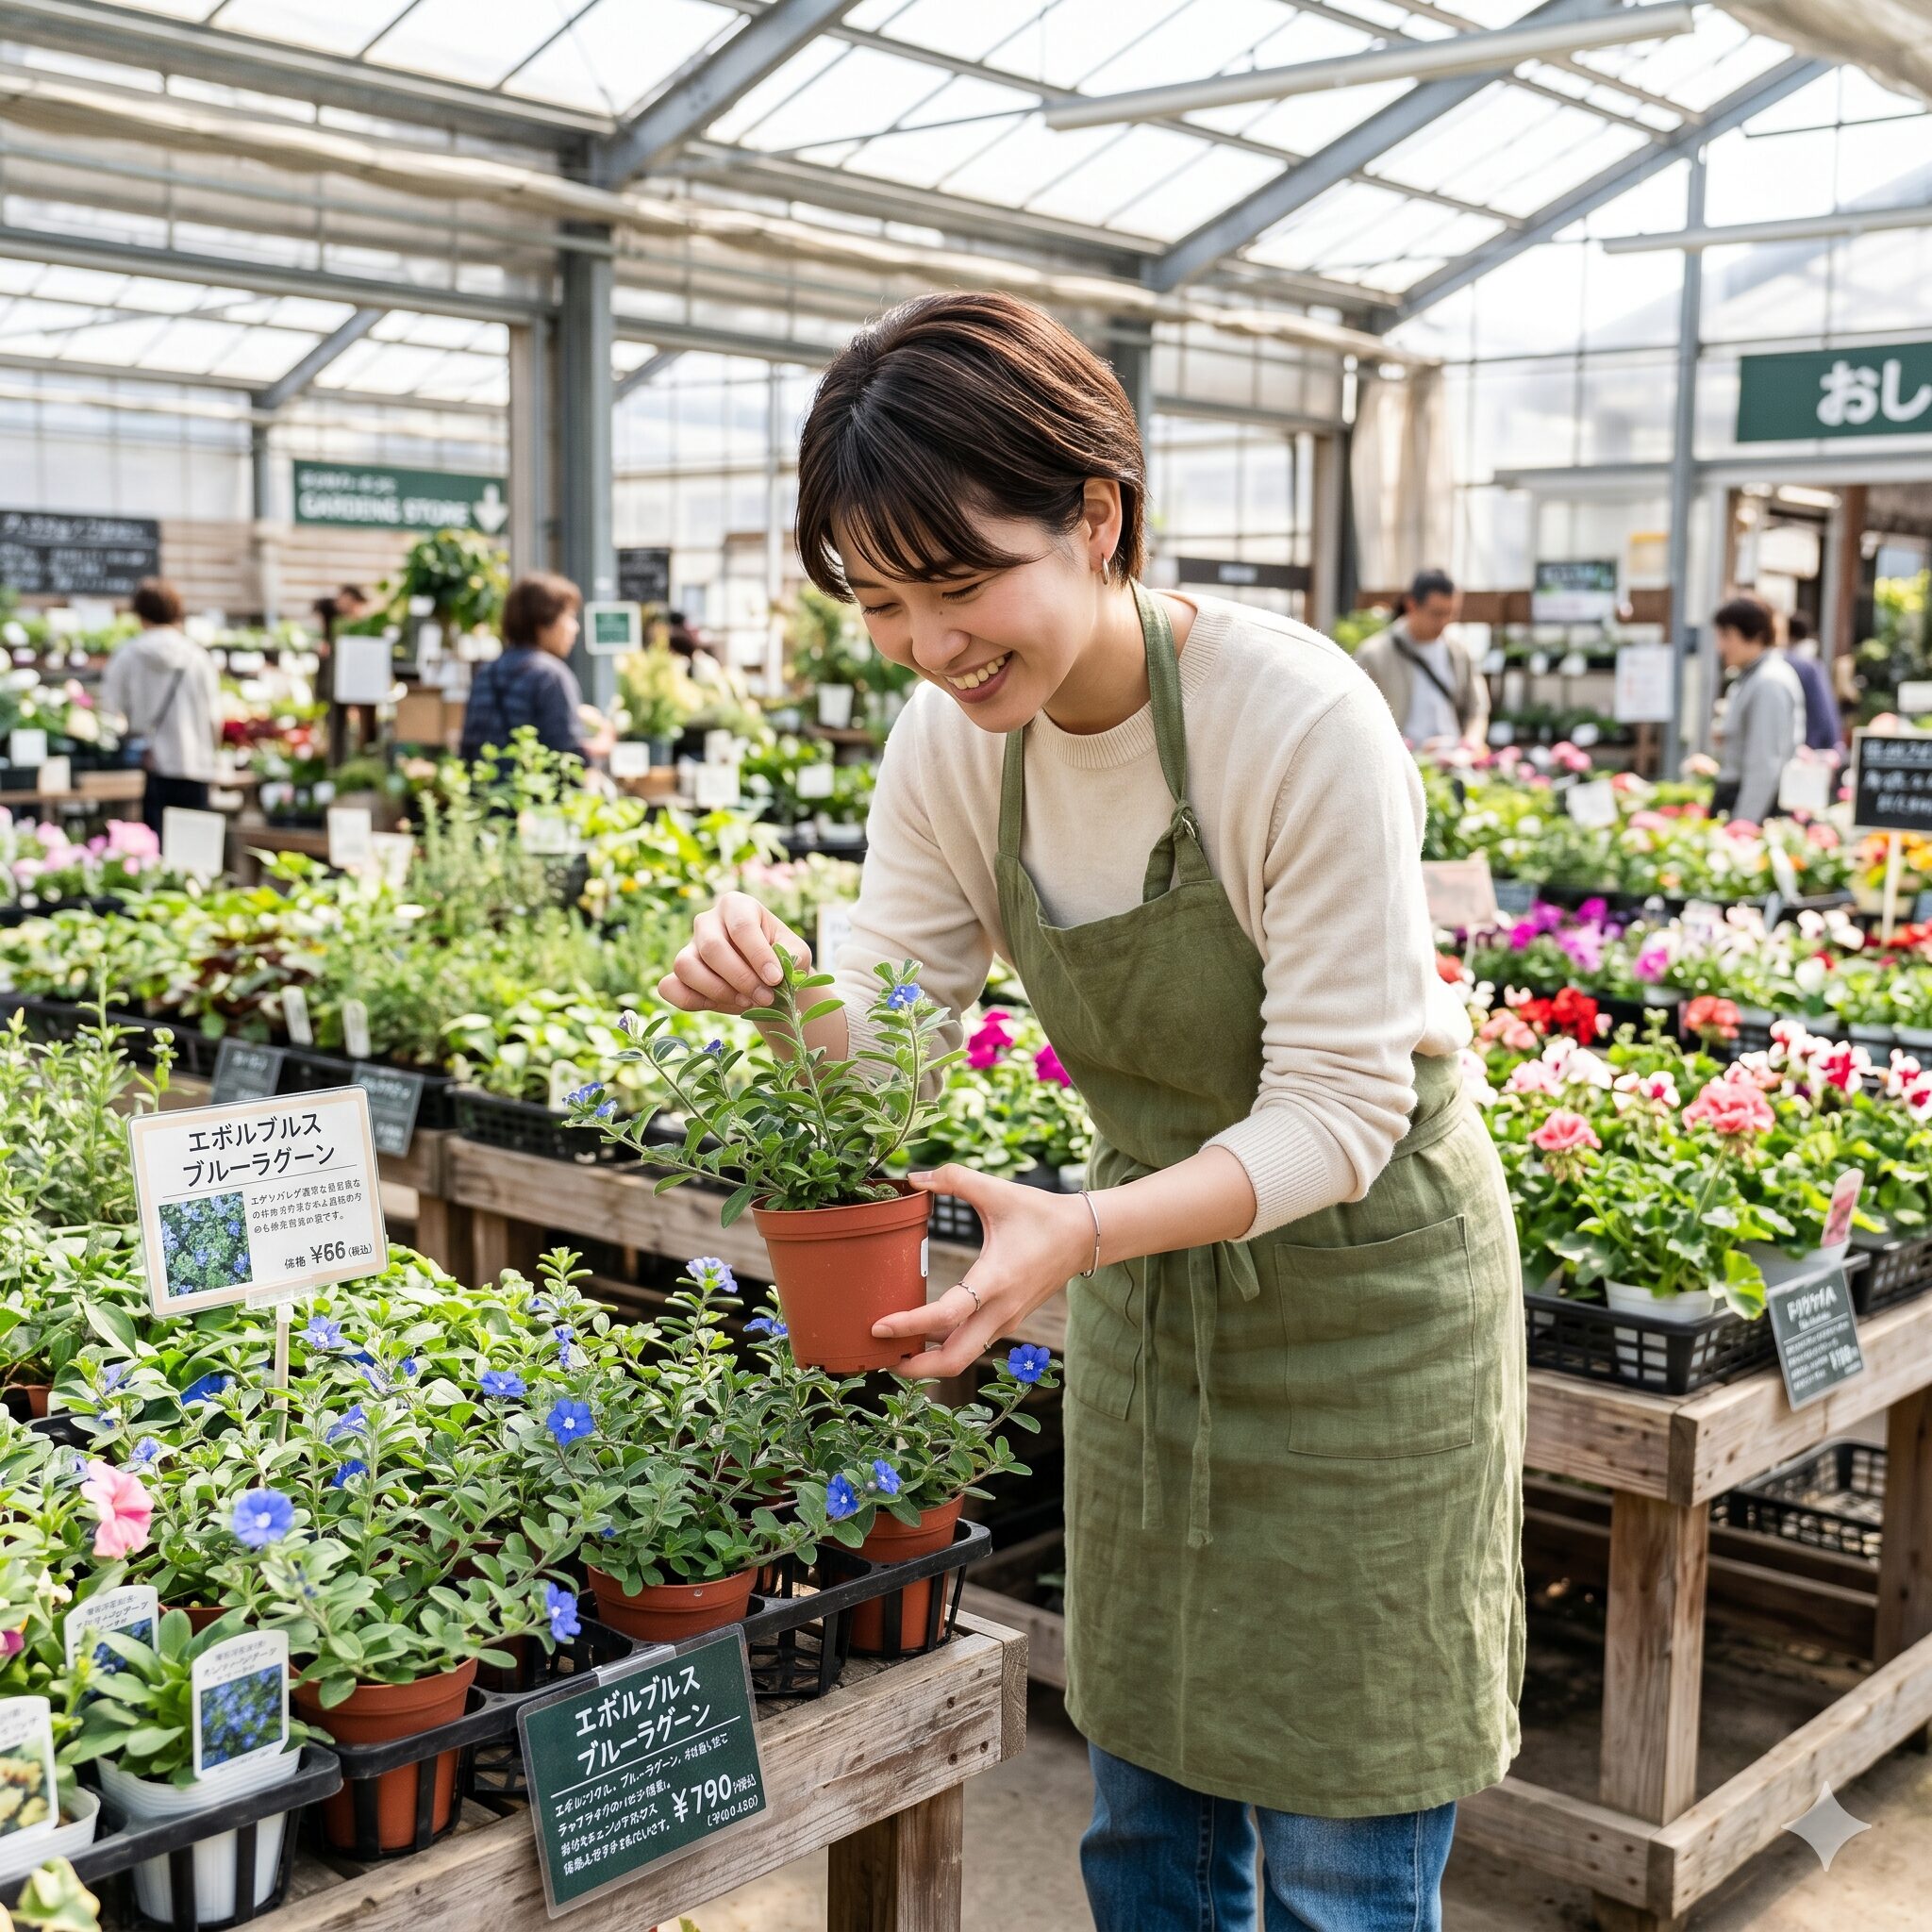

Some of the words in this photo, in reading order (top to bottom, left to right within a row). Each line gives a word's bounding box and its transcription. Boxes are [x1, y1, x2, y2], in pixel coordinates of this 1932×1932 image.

[1817, 358, 1932, 426] おし
[188, 1112, 322, 1153] エボルブルス
[183, 1144, 335, 1187] ブルーラグーン
[575, 1665, 701, 1737] エボルブルス
[577, 1704, 711, 1776] ブルーラグーン
[672, 1774, 732, 1823] ¥790
